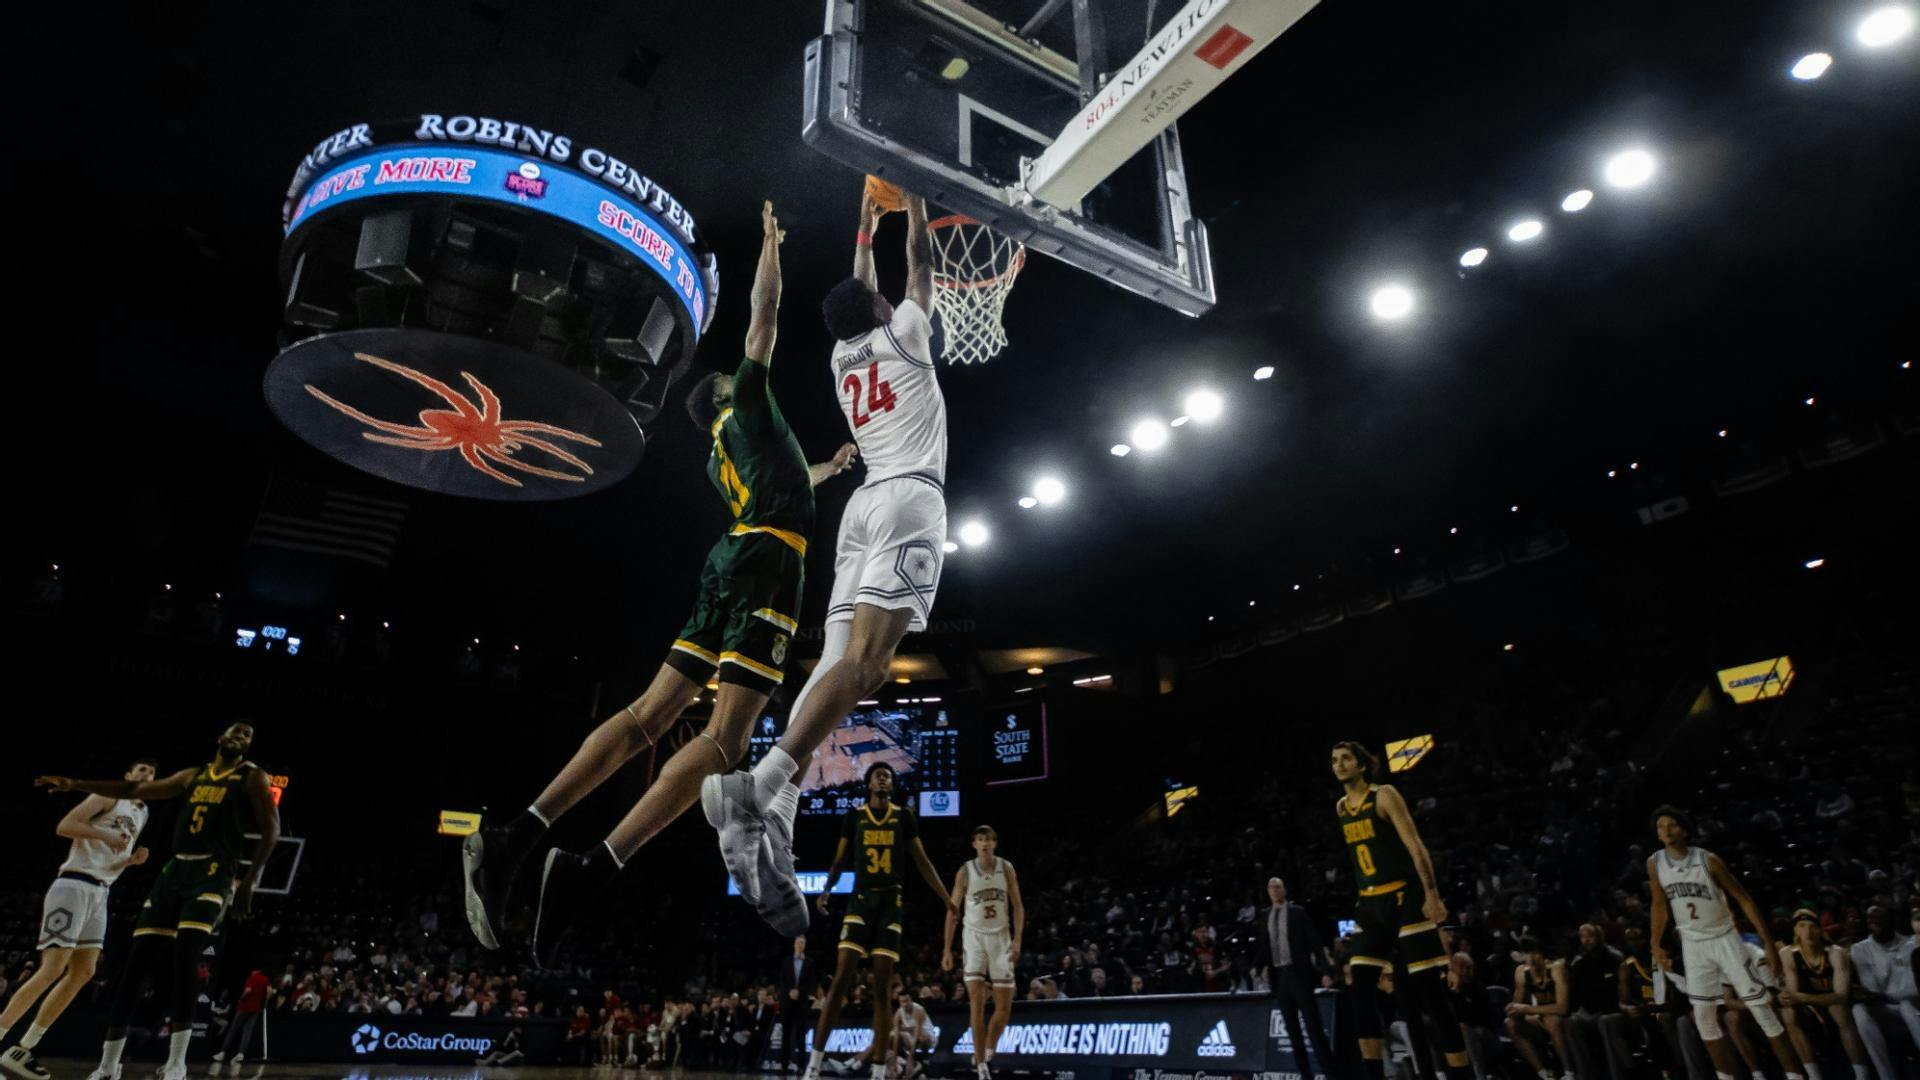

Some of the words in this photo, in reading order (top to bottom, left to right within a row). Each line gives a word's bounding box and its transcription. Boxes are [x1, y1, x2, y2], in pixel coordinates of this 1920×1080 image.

[374, 156, 477, 185] MORE
[414, 113, 572, 162] ROBINS
[579, 148, 696, 244] CENTER
[598, 200, 675, 272] SCORE
[677, 257, 695, 299] TO
[843, 361, 898, 430] 24
[993, 729, 1031, 745] SOUTH
[995, 742, 1030, 759] STATE
[189, 805, 209, 834] 5
[865, 847, 894, 875] 34
[1355, 843, 1377, 877] 0
[1687, 902, 1700, 920] 2
[995, 1024, 1079, 1055] MPOSSIBLE
[1077, 1023, 1097, 1055] IS
[1094, 1022, 1172, 1056] NOTHING
[1197, 1044, 1237, 1057] adidas
